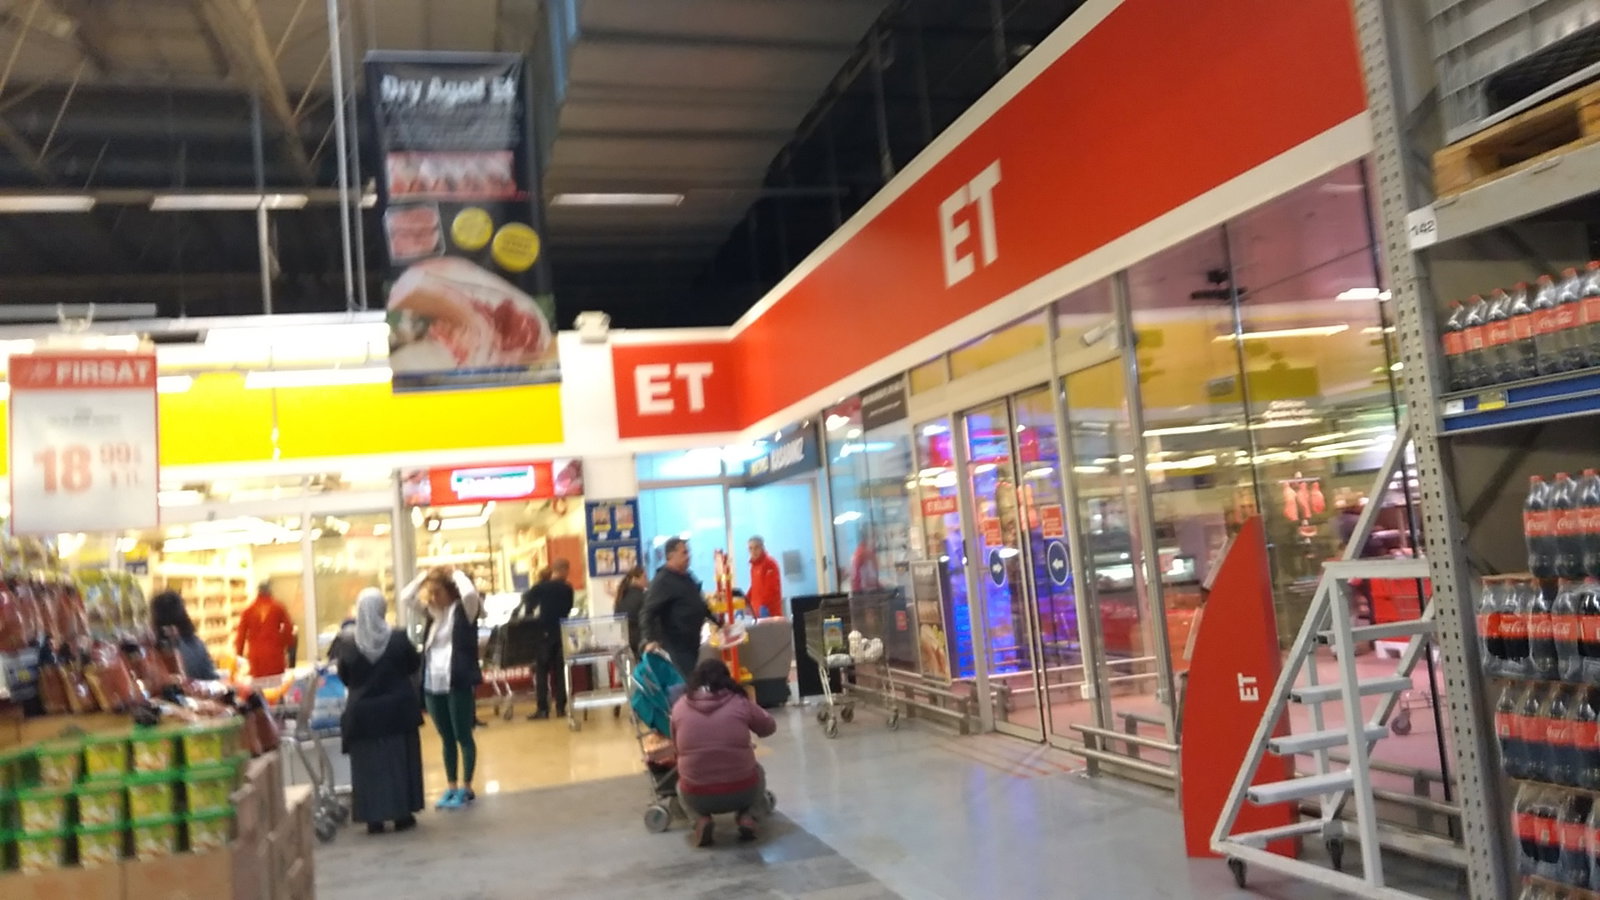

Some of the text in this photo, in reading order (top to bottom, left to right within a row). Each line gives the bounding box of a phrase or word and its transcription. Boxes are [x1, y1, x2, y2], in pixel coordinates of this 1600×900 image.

[381, 74, 423, 108] Dry
[426, 75, 486, 108] Aged
[938, 158, 1002, 289] ET
[56, 360, 149, 384] FIRSAT
[634, 361, 714, 415] ET
[34, 443, 92, 494] 18
[1237, 672, 1259, 701] ET
